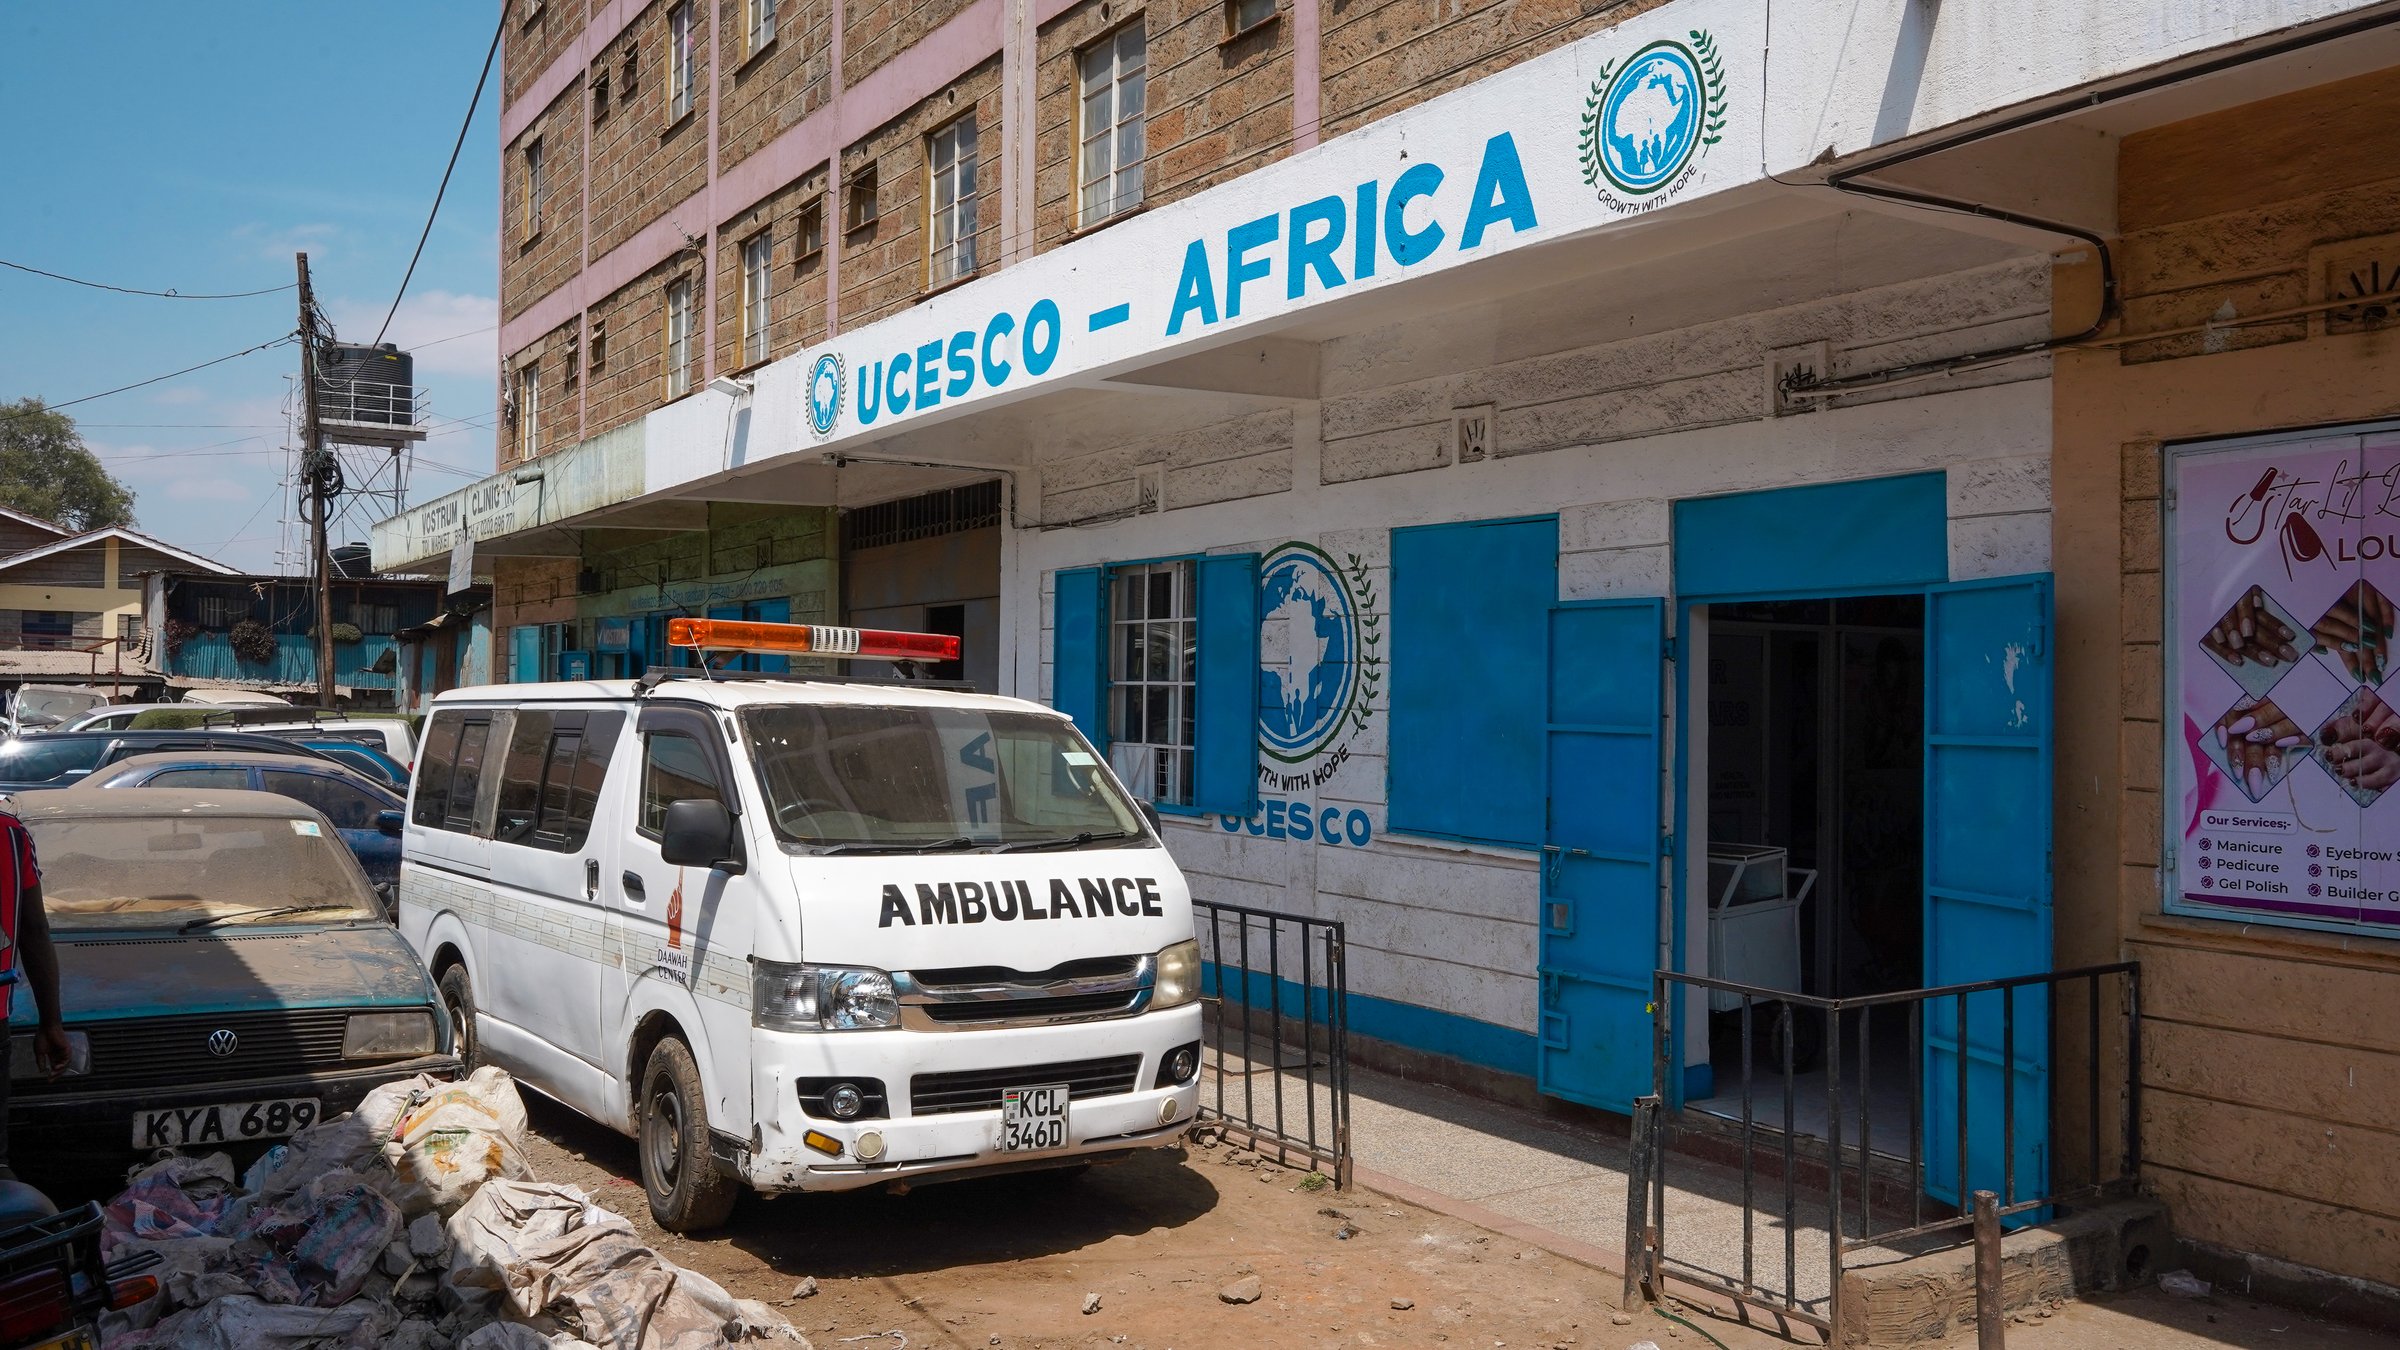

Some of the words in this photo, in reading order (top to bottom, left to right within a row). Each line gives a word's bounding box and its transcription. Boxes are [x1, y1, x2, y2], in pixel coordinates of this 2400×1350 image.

[1597, 188, 1640, 214] GROWTH
[1641, 192, 1667, 213] WITH
[1669, 163, 1697, 198] HOPE
[857, 299, 1061, 425] UCESCO
[1165, 131, 1538, 336] AFRICA
[421, 500, 458, 536] VOSTRUM
[472, 483, 500, 516] CLINIC
[1281, 771, 1310, 792] WITH
[1313, 743, 1351, 786] HOPE
[2206, 815, 2230, 826] Our
[2216, 839, 2283, 855] Manicure
[2326, 846, 2393, 861] Eyebrow
[2216, 858, 2280, 874] Pedicure
[2326, 865, 2358, 881] Tips
[2219, 878, 2242, 891] Gel
[2246, 879, 2289, 894] Polish
[2327, 886, 2384, 901] Builder
[879, 877, 1163, 928] AMBULANCE
[657, 948, 688, 969] DAAWAH
[658, 966, 687, 984] CENTER
[1020, 1089, 1063, 1119] KCL
[146, 1106, 225, 1146] KYA
[239, 1101, 317, 1137] 689
[1006, 1119, 1062, 1151] 346D
